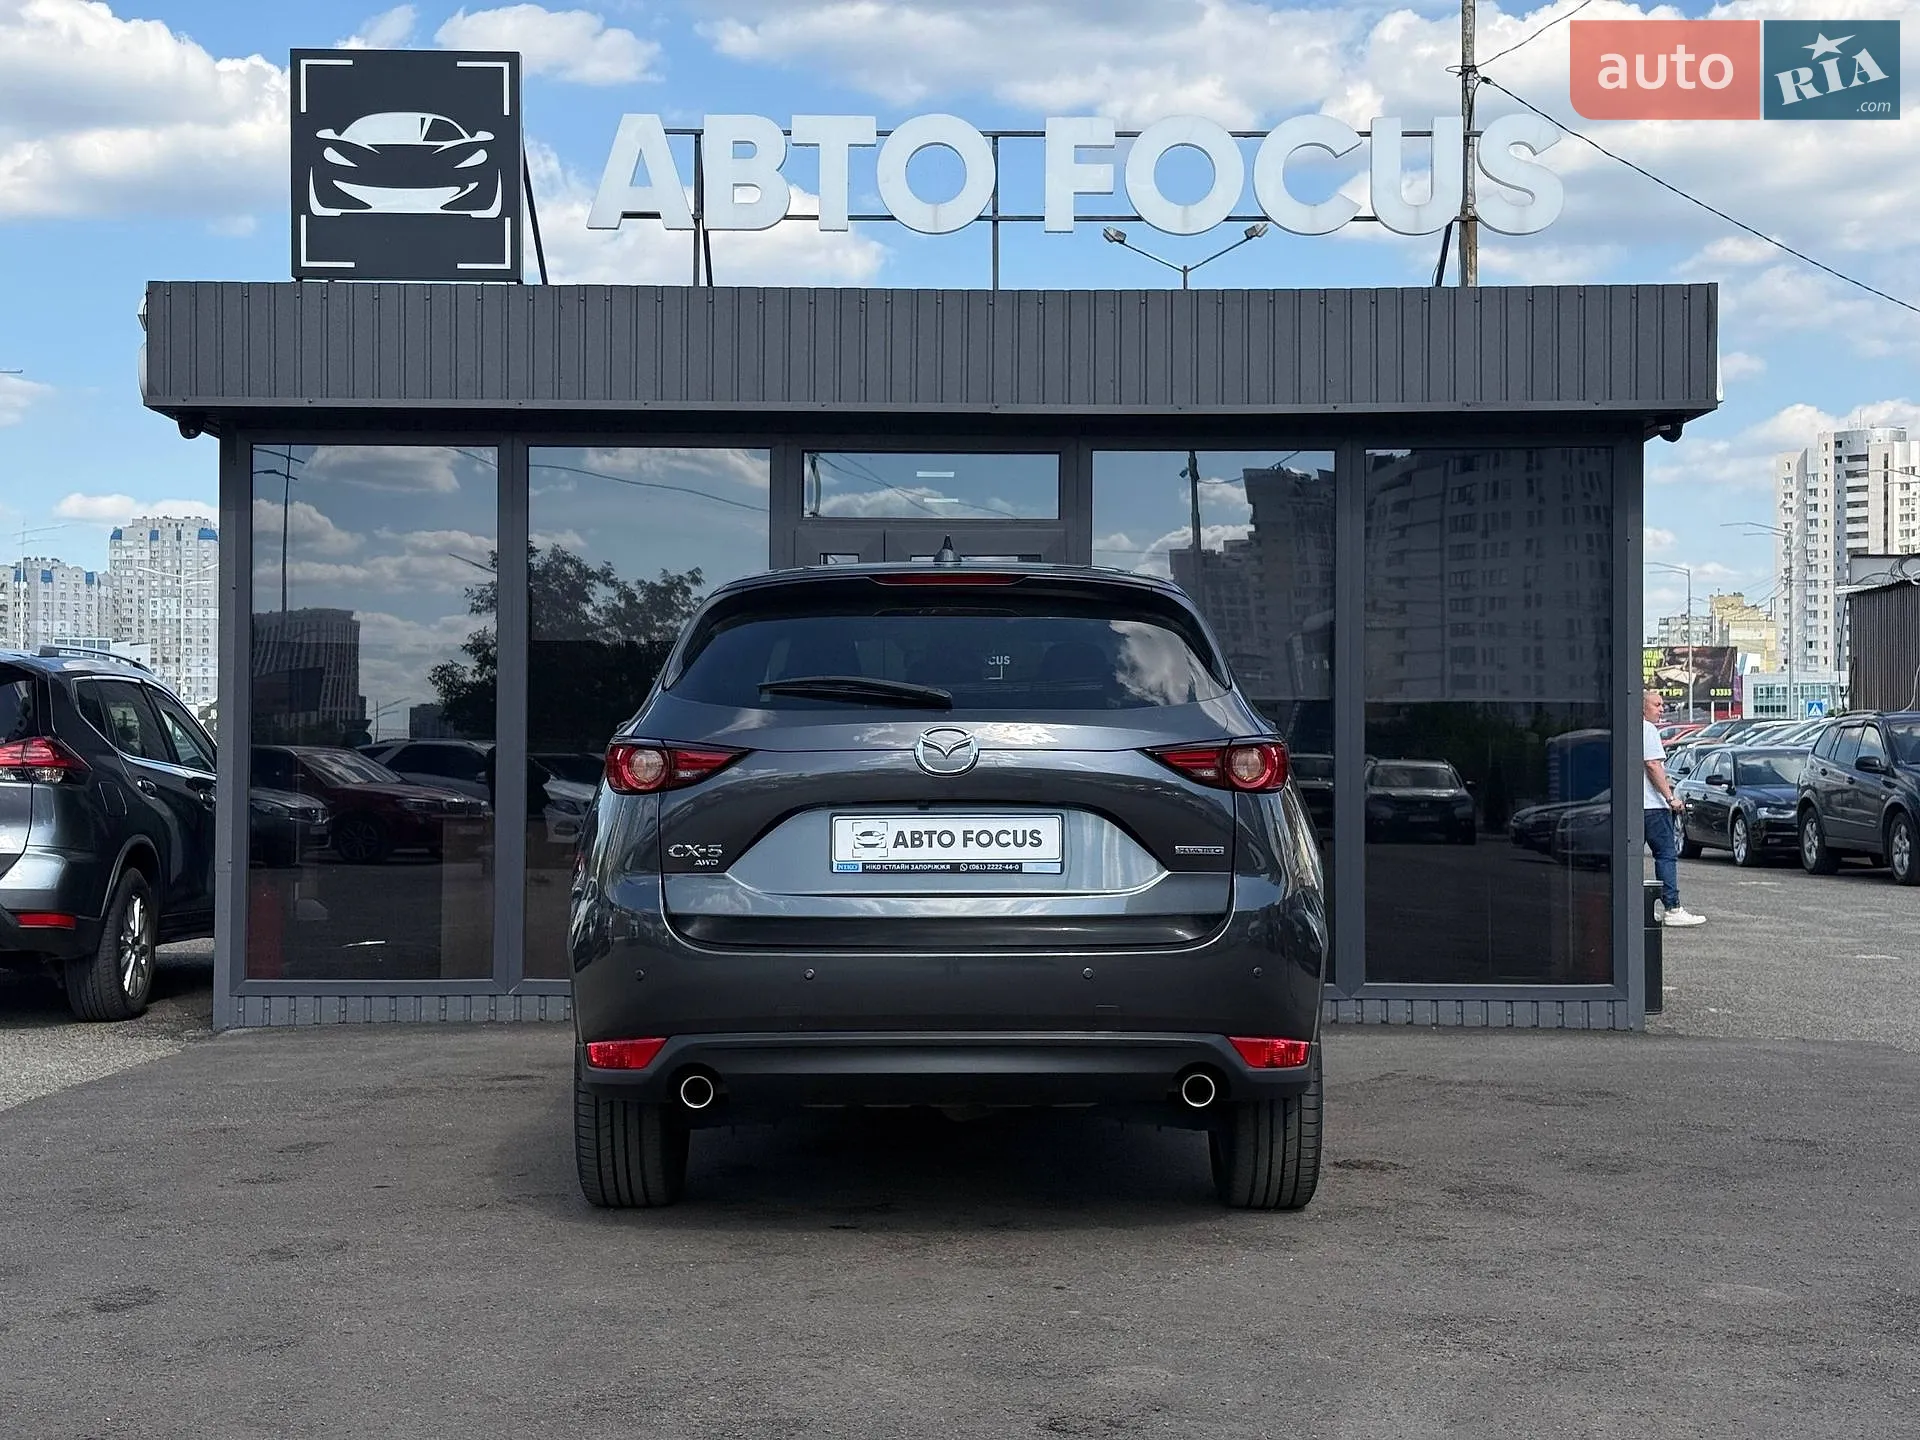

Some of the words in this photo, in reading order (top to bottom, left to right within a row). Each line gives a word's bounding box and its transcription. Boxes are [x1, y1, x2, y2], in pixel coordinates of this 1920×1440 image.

[586, 113, 996, 234] АВТО
[1044, 114, 1564, 235] FOCUS
[892, 830, 956, 848] АВТО
[962, 830, 1043, 848] FOCUS
[668, 844, 723, 858] CX-5
